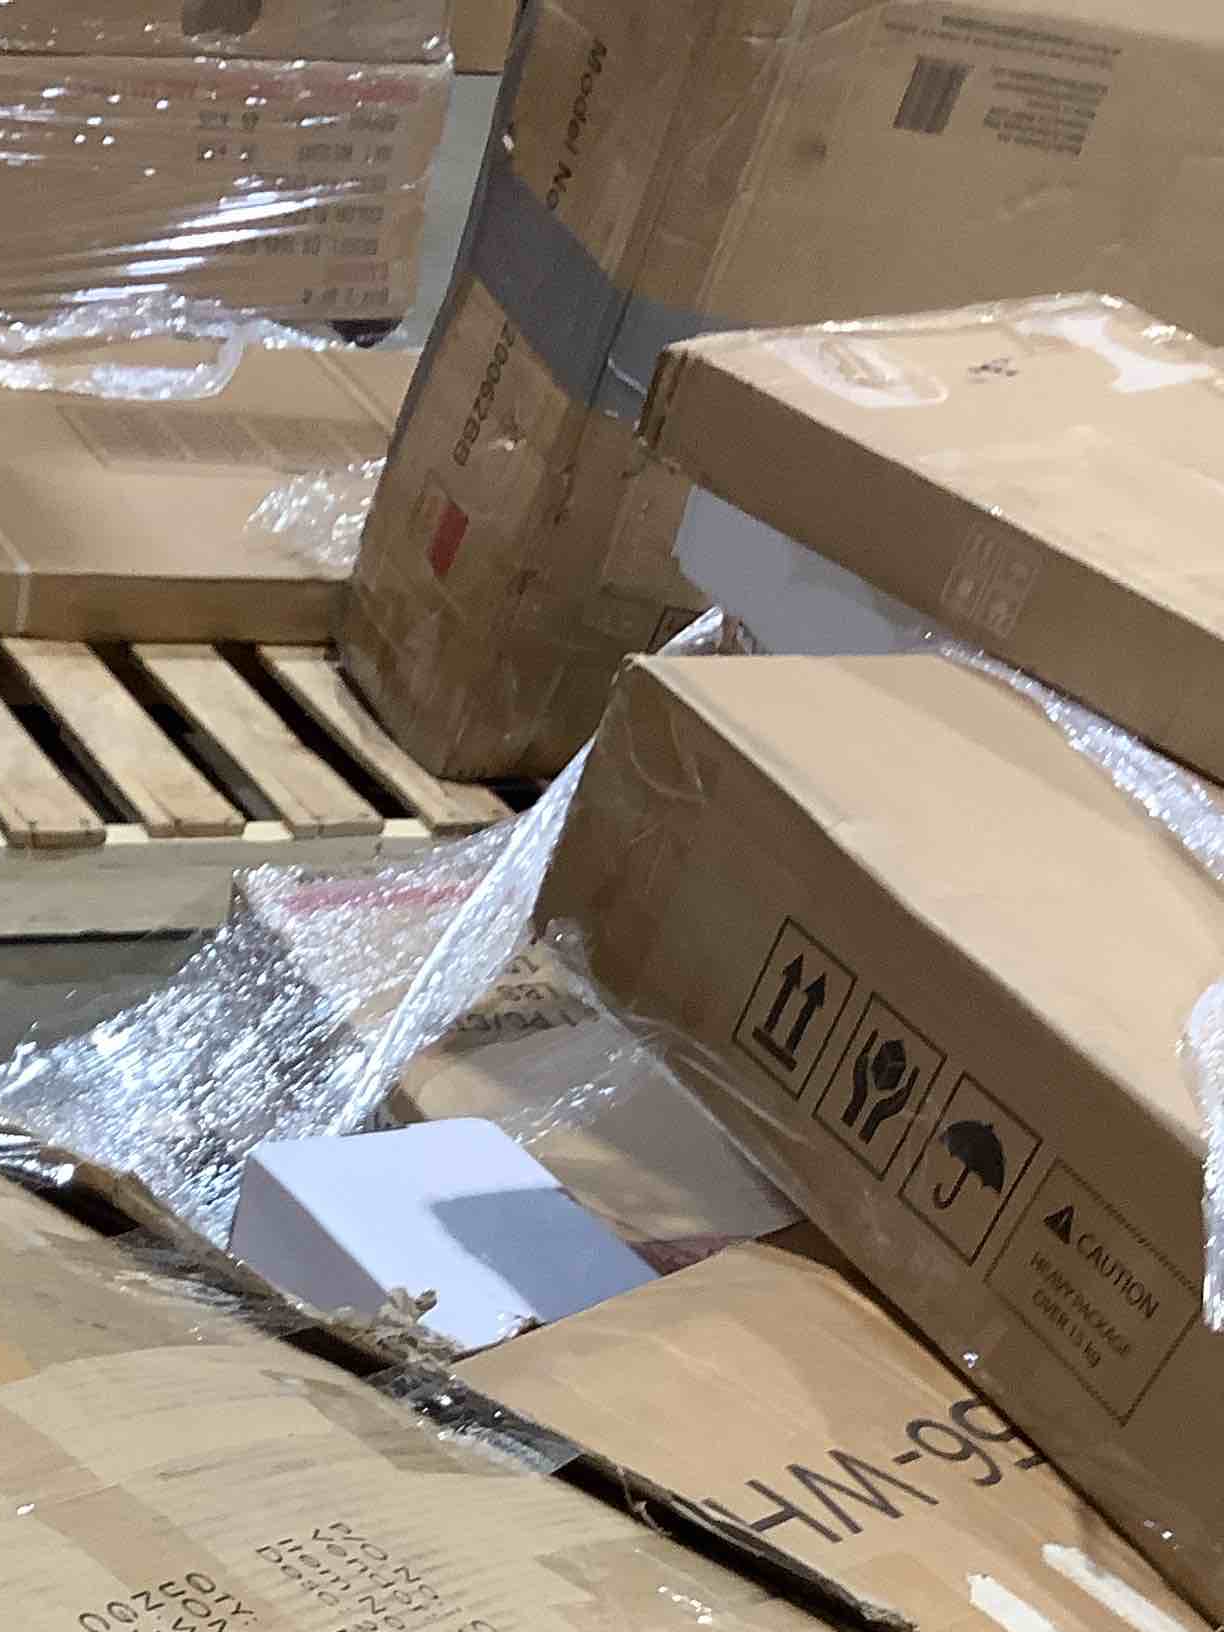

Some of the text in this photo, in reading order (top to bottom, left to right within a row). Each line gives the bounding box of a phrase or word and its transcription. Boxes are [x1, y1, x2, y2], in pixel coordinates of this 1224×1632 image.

[564, 37, 607, 156] Model
[1076, 1231, 1160, 1320] CAUTION
[277, 1537, 351, 1592] Item
[328, 1521, 388, 1562] P/O
